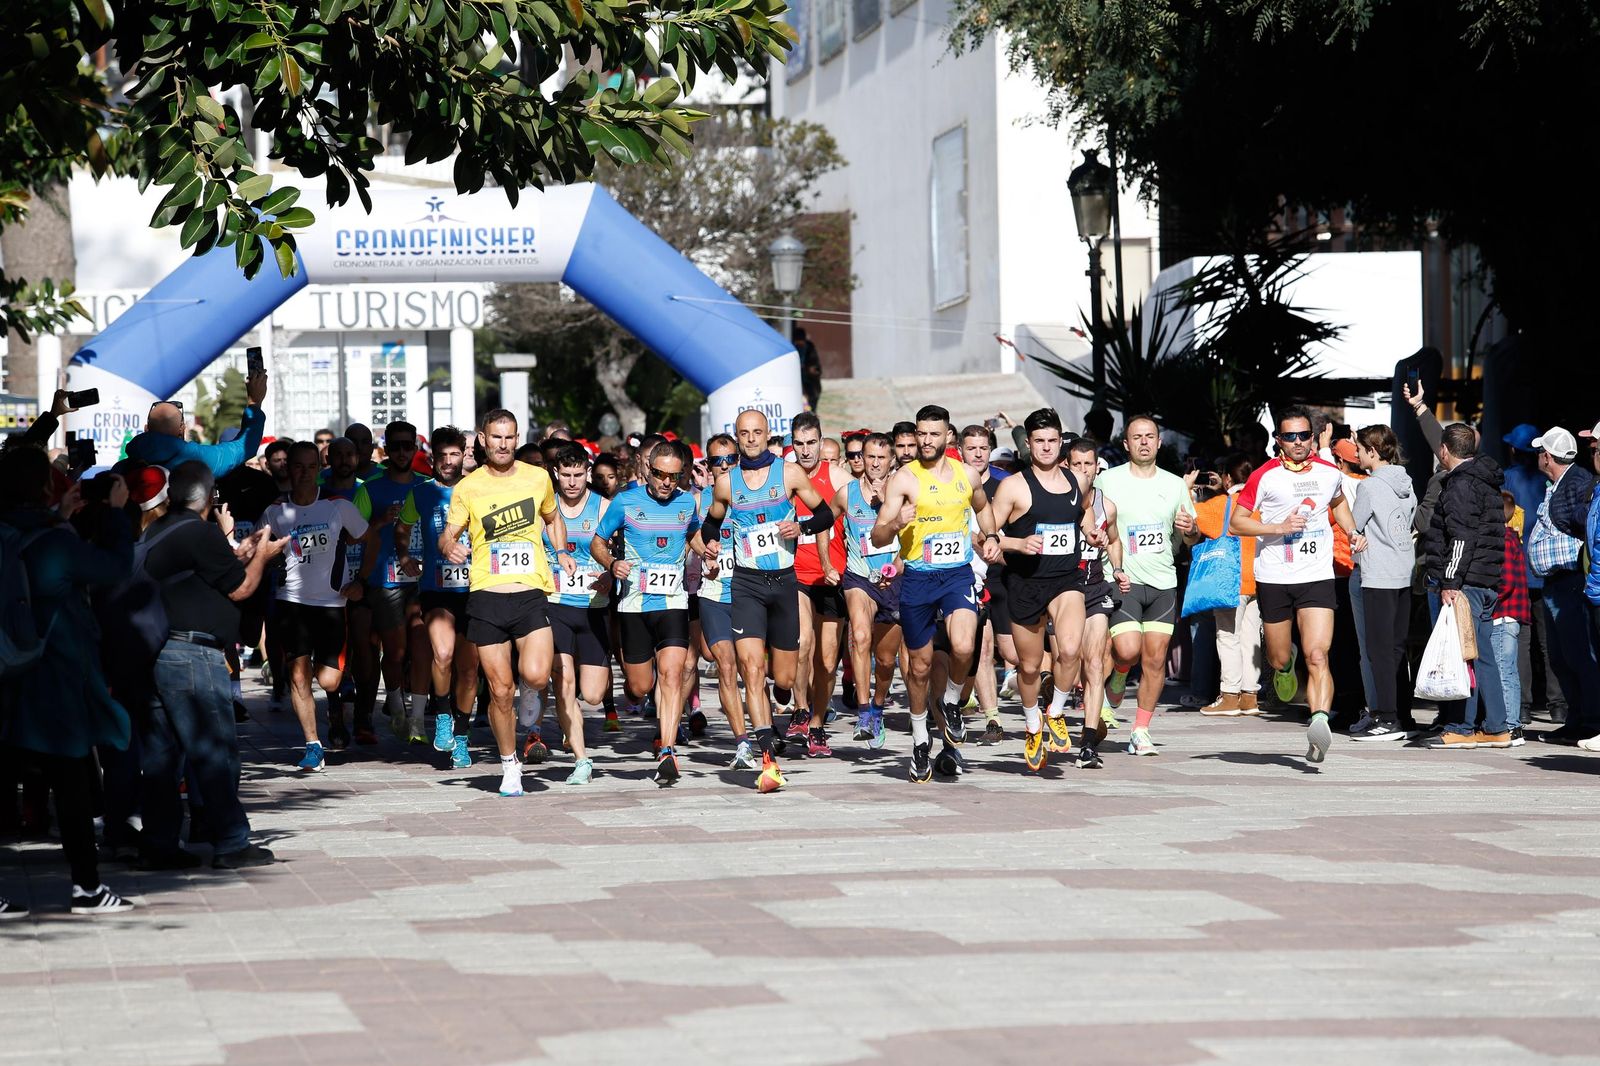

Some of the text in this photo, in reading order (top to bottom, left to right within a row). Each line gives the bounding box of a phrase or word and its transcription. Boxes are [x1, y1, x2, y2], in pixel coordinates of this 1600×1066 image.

[336, 227, 536, 256] CRONOFINISHER
[333, 260, 404, 268] CRONOMETRAJE
[483, 258, 495, 266] DE
[498, 257, 539, 266] EVENTOS
[309, 290, 479, 329] TURISMO
[94, 412, 140, 429] CRONO
[492, 505, 523, 529] XIII
[300, 533, 328, 549] 216
[757, 532, 775, 548] 81
[1050, 534, 1068, 547] 26
[1138, 532, 1164, 547] 223
[934, 541, 960, 556] 232
[1299, 541, 1317, 555] 48
[501, 552, 530, 566] 218
[444, 567, 469, 581] 219
[567, 574, 583, 587] 31
[649, 573, 677, 587] 217
